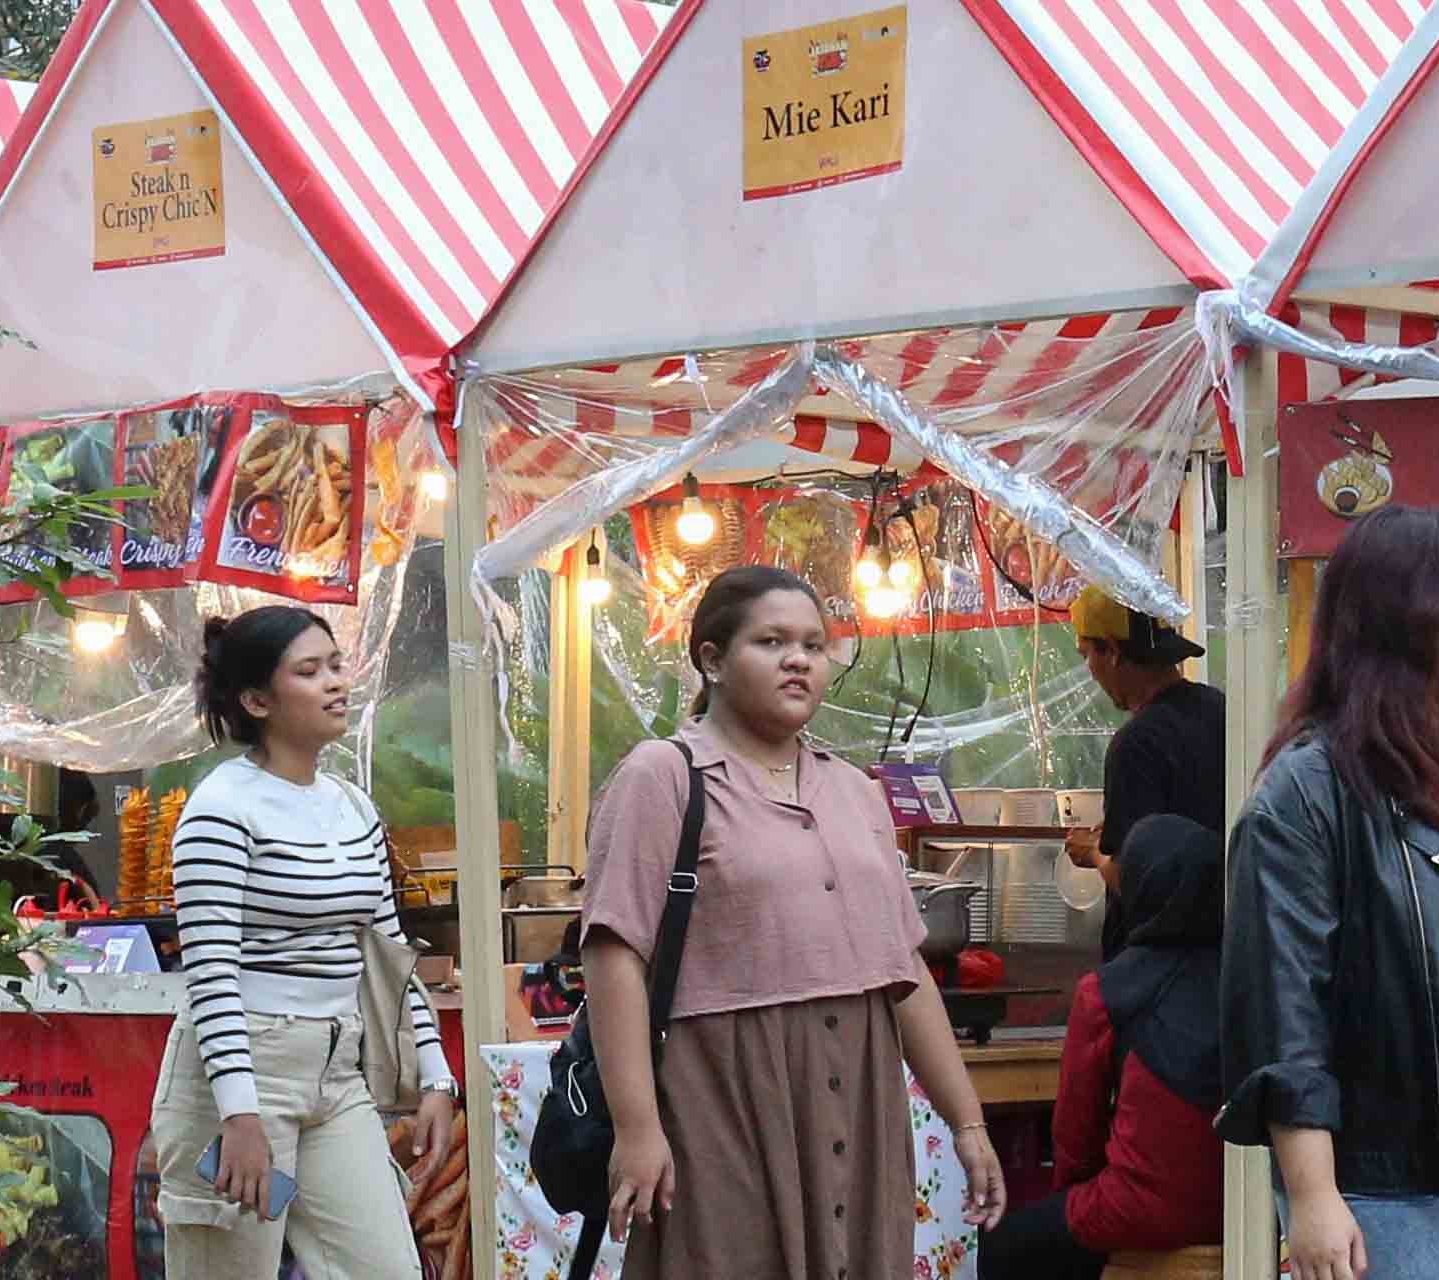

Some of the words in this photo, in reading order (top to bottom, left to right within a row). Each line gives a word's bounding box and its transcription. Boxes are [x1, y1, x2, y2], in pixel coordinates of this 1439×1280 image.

[762, 101, 820, 140] Mie
[830, 83, 890, 129] Kari
[130, 167, 175, 198] Steak
[180, 172, 190, 190] n
[102, 201, 159, 233] Crispy
[120, 536, 184, 569] Crispy
